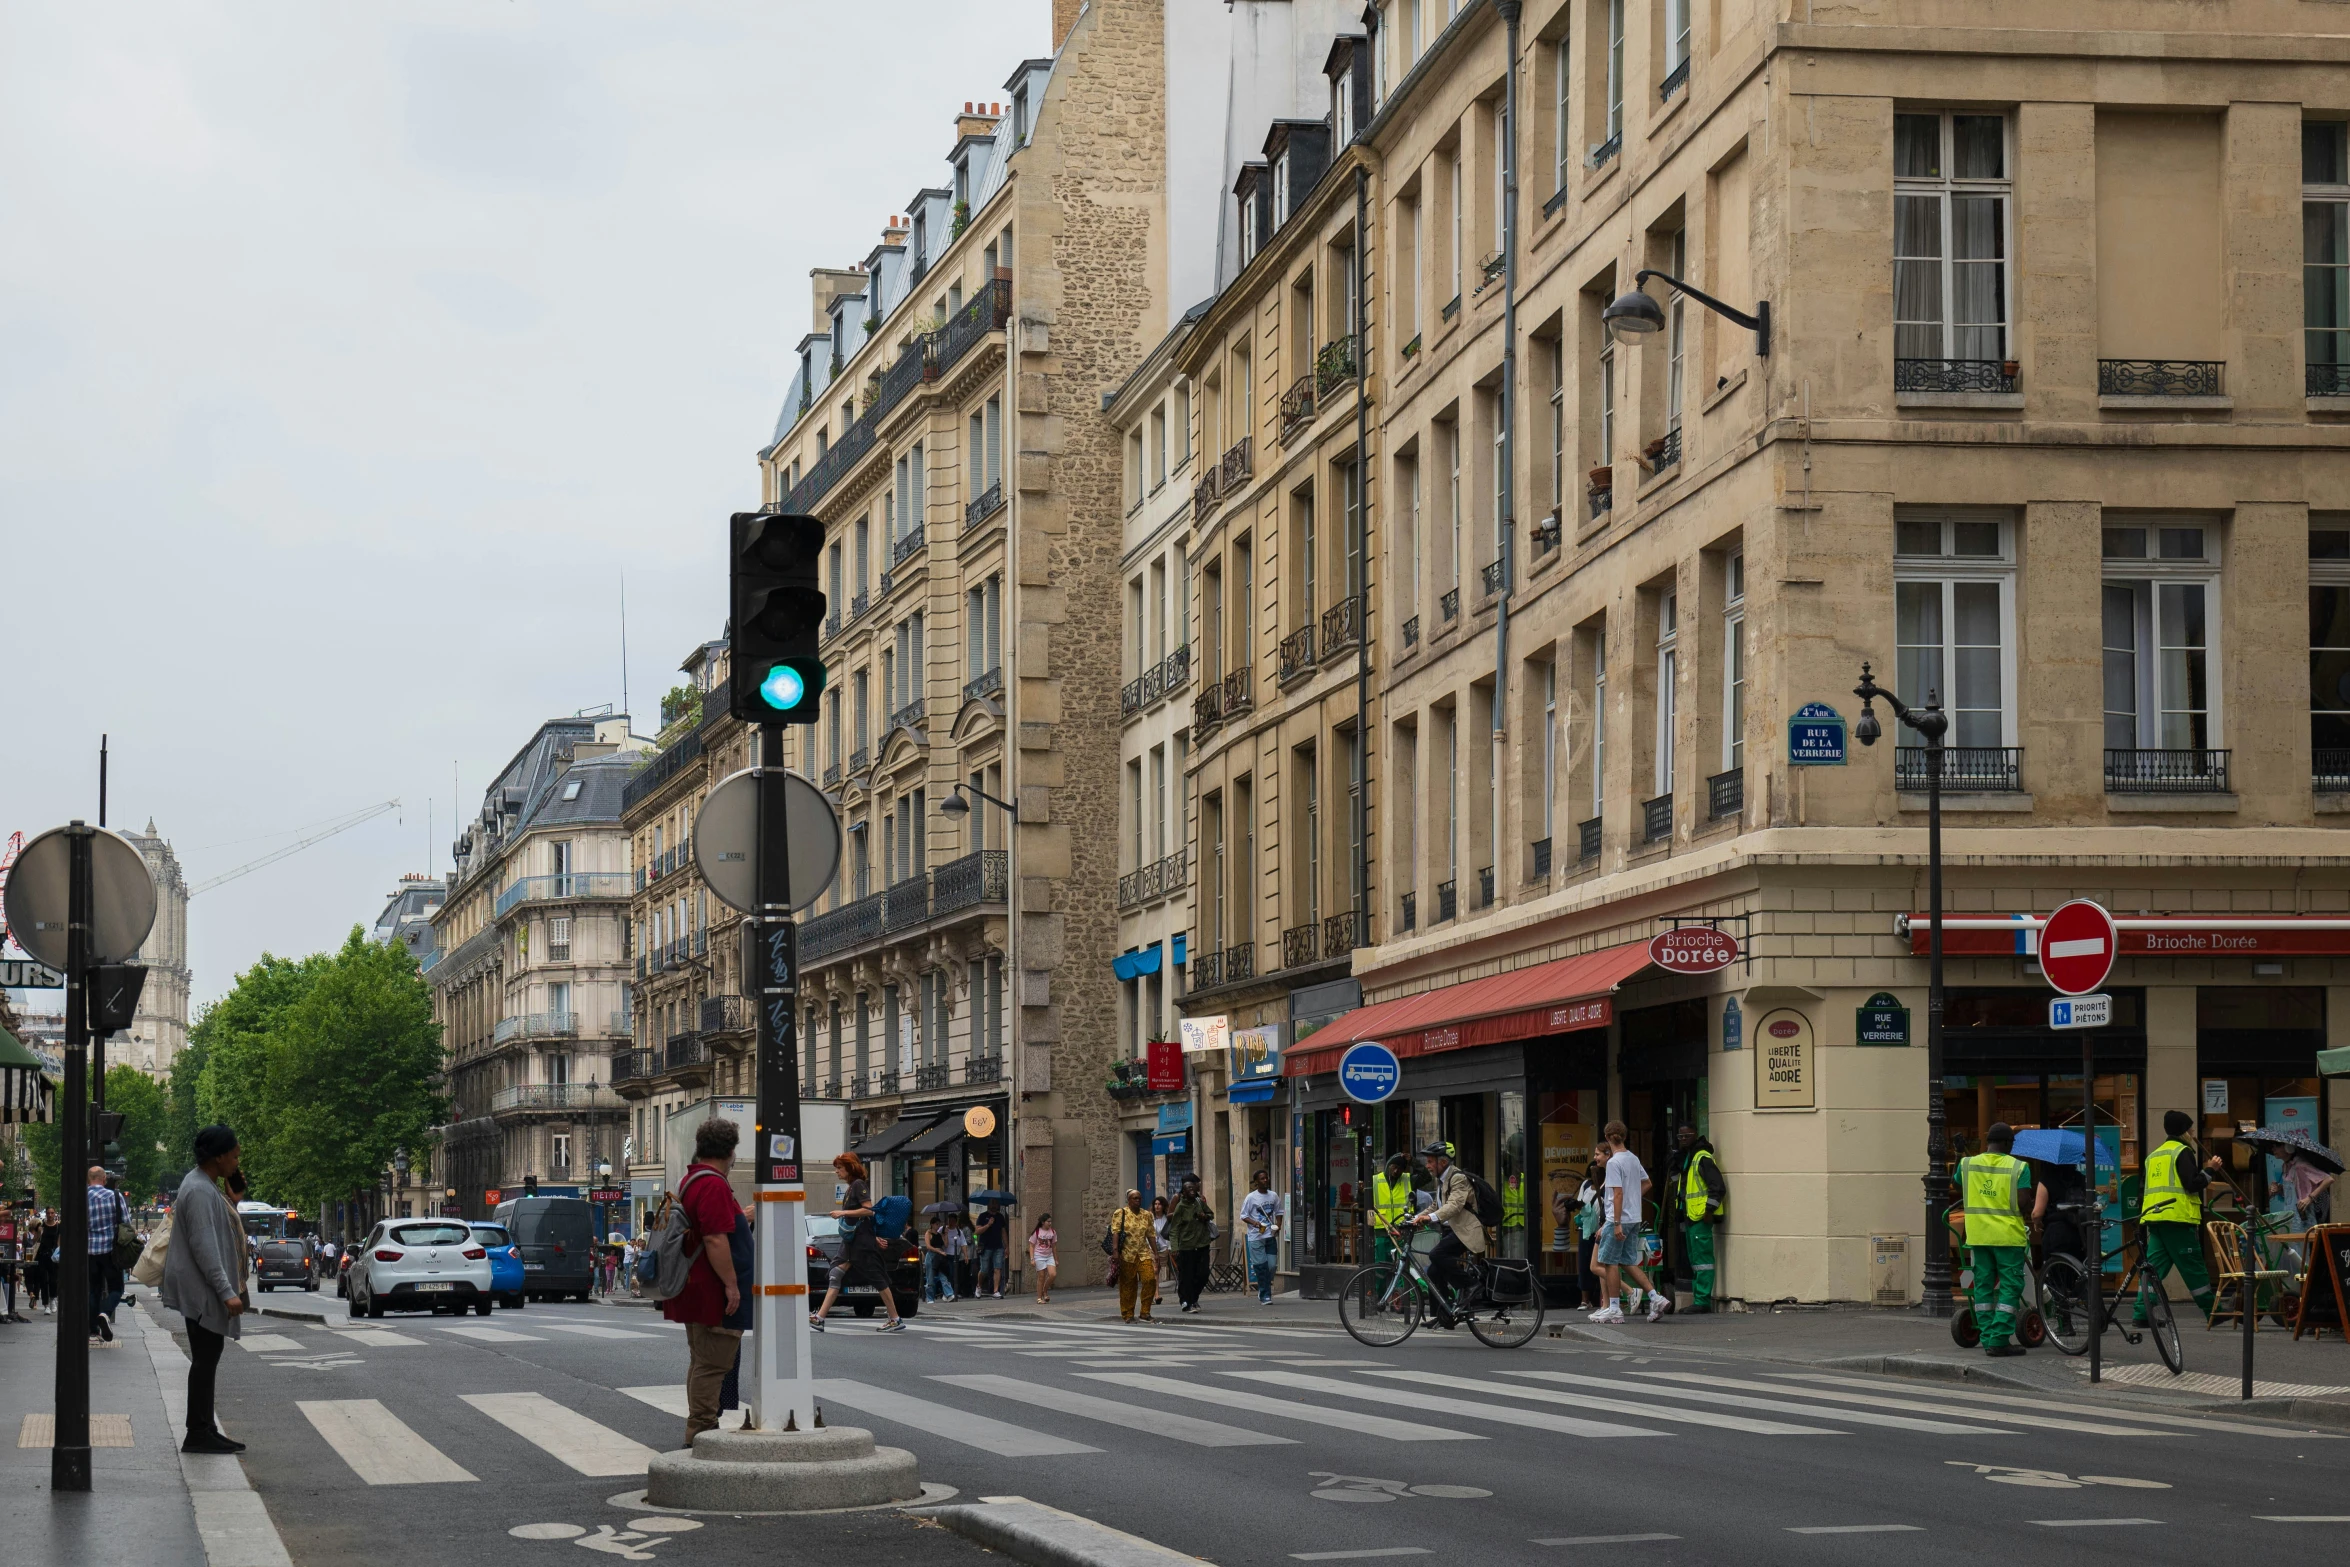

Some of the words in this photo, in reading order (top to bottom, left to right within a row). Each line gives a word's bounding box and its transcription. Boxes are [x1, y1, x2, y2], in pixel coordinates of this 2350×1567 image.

[1807, 728, 1829, 737] RUE
[1802, 738, 1816, 747] DE
[1819, 739, 1833, 747] LA
[1792, 749, 1842, 758] VERRERIE
[1666, 933, 1723, 948] Brioche
[2146, 934, 2206, 949] Brioche
[2211, 934, 2258, 949] Dorée
[1661, 947, 1730, 964] Dorée
[2074, 1000, 2107, 1012] PRIORITÉ
[1874, 1013, 1892, 1022] RUE
[2075, 1013, 2106, 1023] PIÉTONS
[1863, 1031, 1904, 1040] VERRERIE
[1561, 1156, 1569, 1164] DE
[1569, 1154, 1588, 1164] MAIN
[774, 1166, 796, 1179] IWOS
[1979, 1188, 1997, 1198] PARIS
